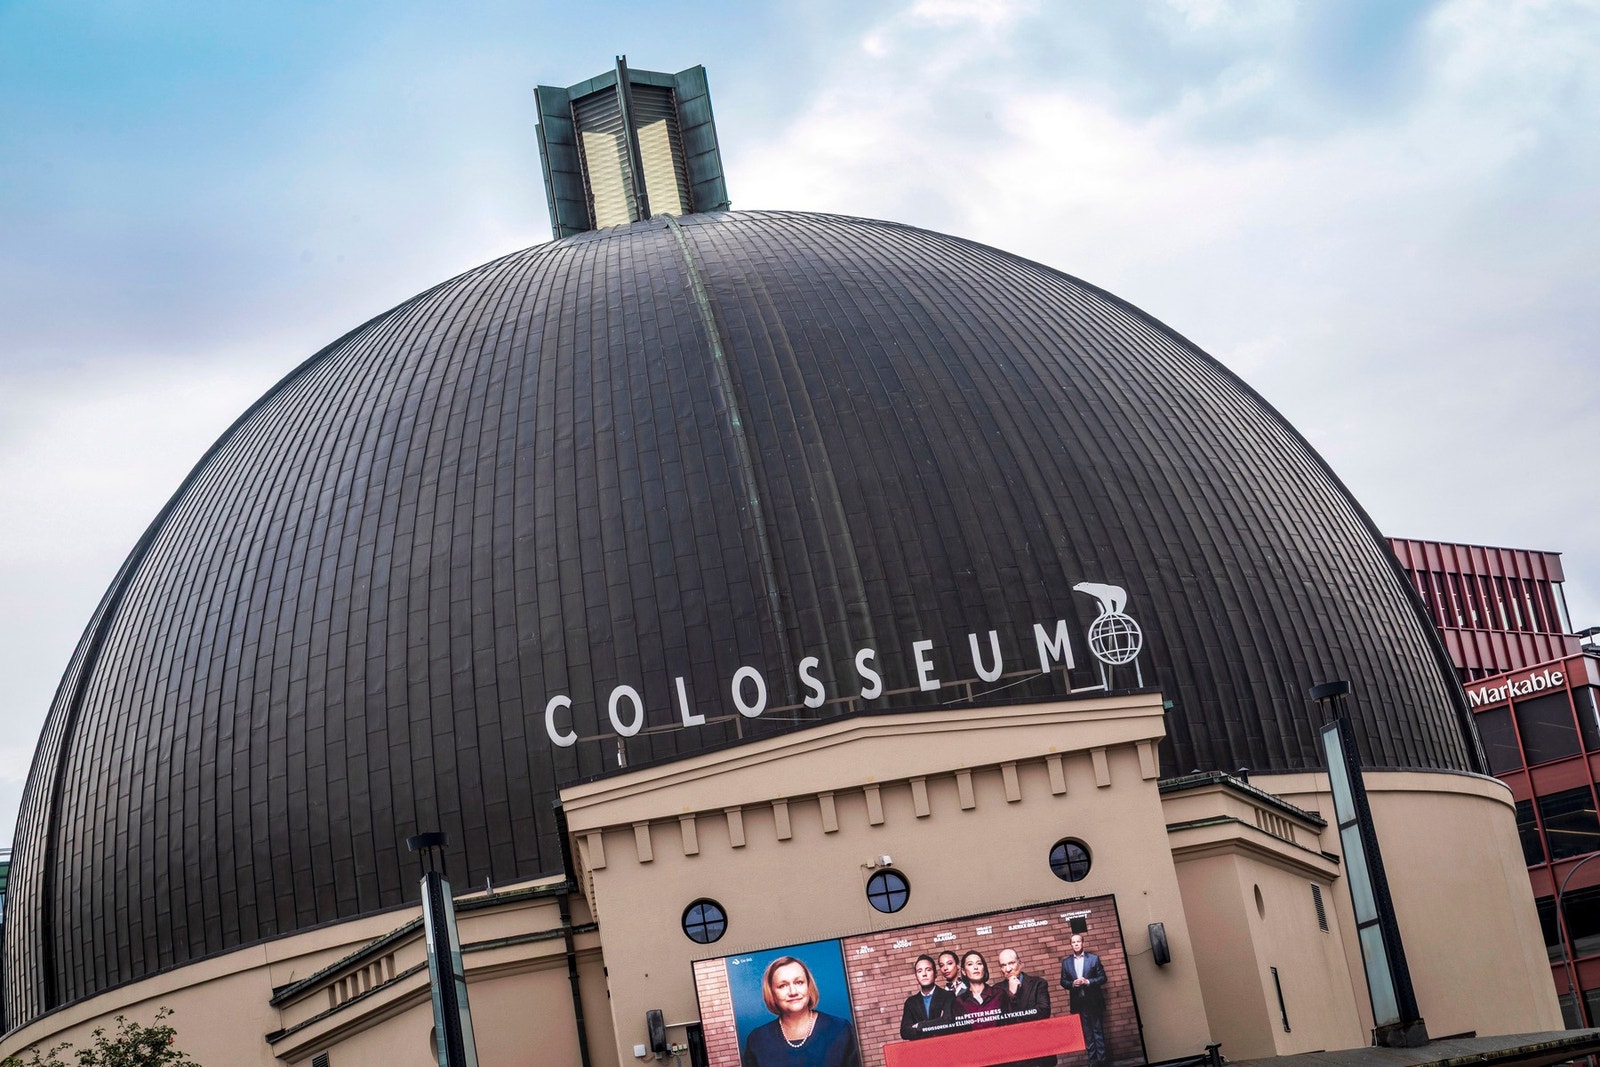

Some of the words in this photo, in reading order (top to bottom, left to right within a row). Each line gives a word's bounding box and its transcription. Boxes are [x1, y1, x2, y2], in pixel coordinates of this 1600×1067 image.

[545, 619, 1075, 748] COLOSSEUM
[1468, 669, 1564, 708] Markable
[963, 1011, 985, 1020] PETTER
[1004, 1008, 1038, 1019] LYKKELAND
